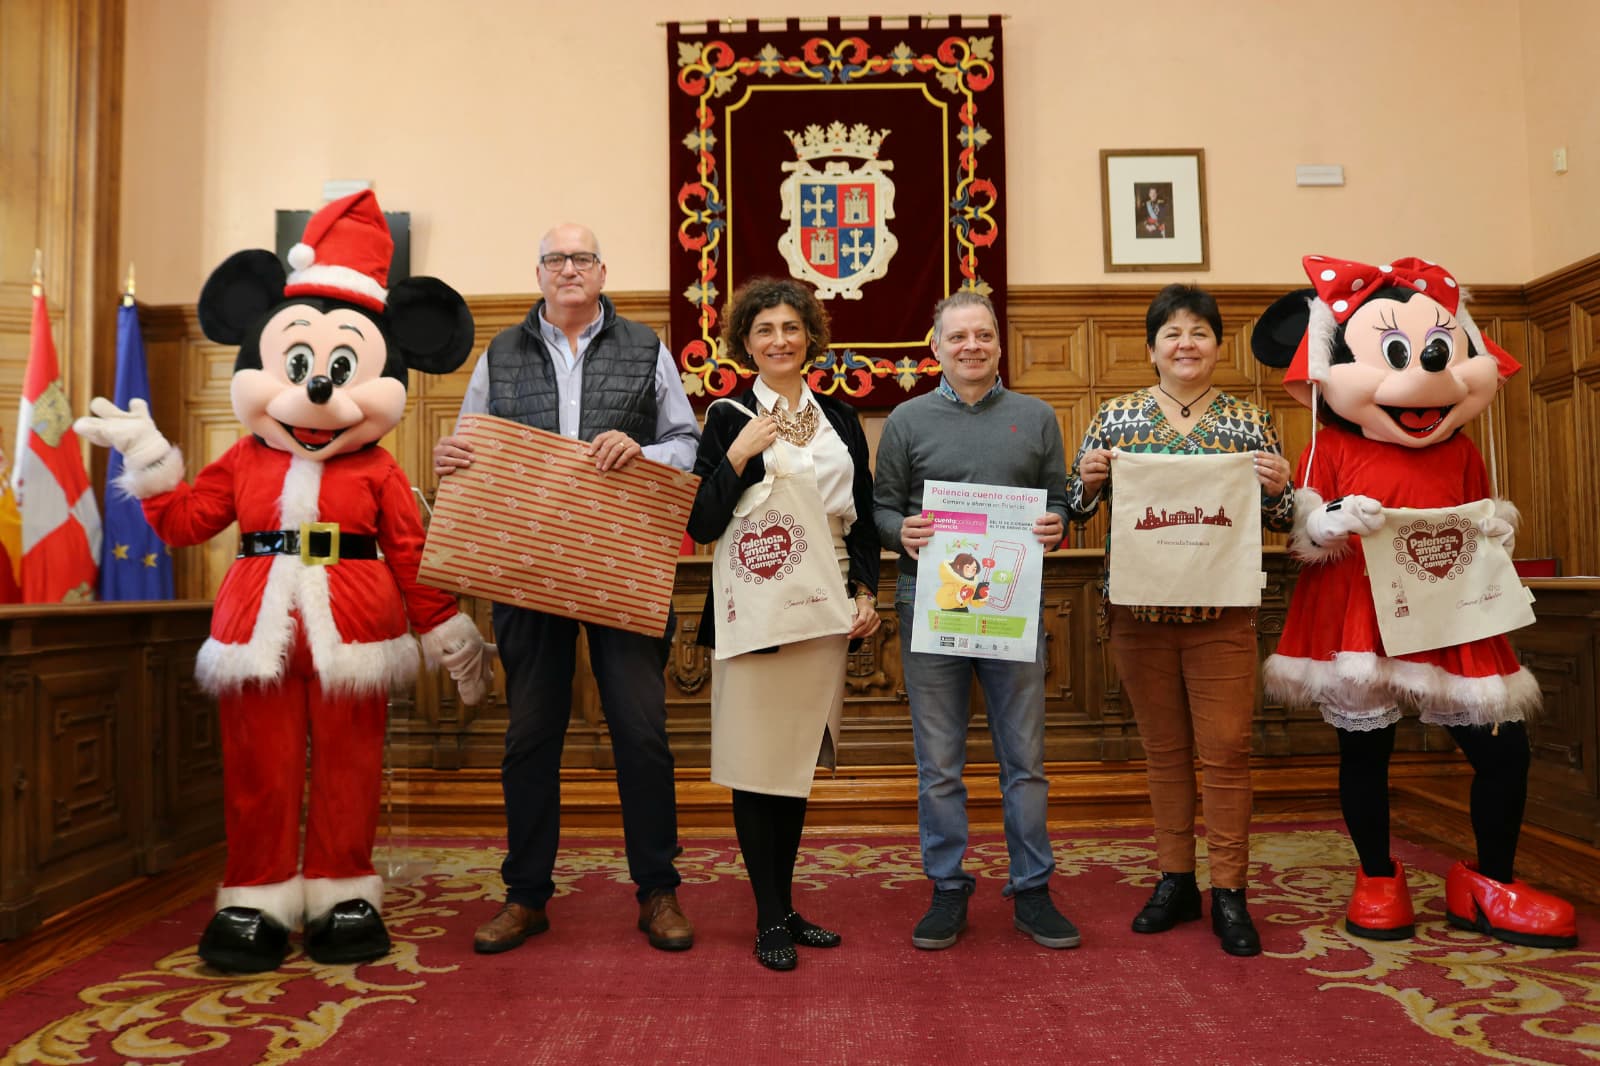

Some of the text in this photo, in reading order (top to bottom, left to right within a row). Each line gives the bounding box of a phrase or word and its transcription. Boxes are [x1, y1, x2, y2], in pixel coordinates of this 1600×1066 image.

[932, 487, 1039, 503] Palencia cuenta contigo
[740, 535, 787, 552] Palencia,
[1410, 535, 1459, 549] Palencia,
[1415, 543, 1452, 556] amor a
[743, 543, 780, 558] amor a
[1418, 550, 1458, 565] primera
[745, 550, 787, 567] primera
[750, 558, 783, 570] compra
[1423, 558, 1453, 569] compra
